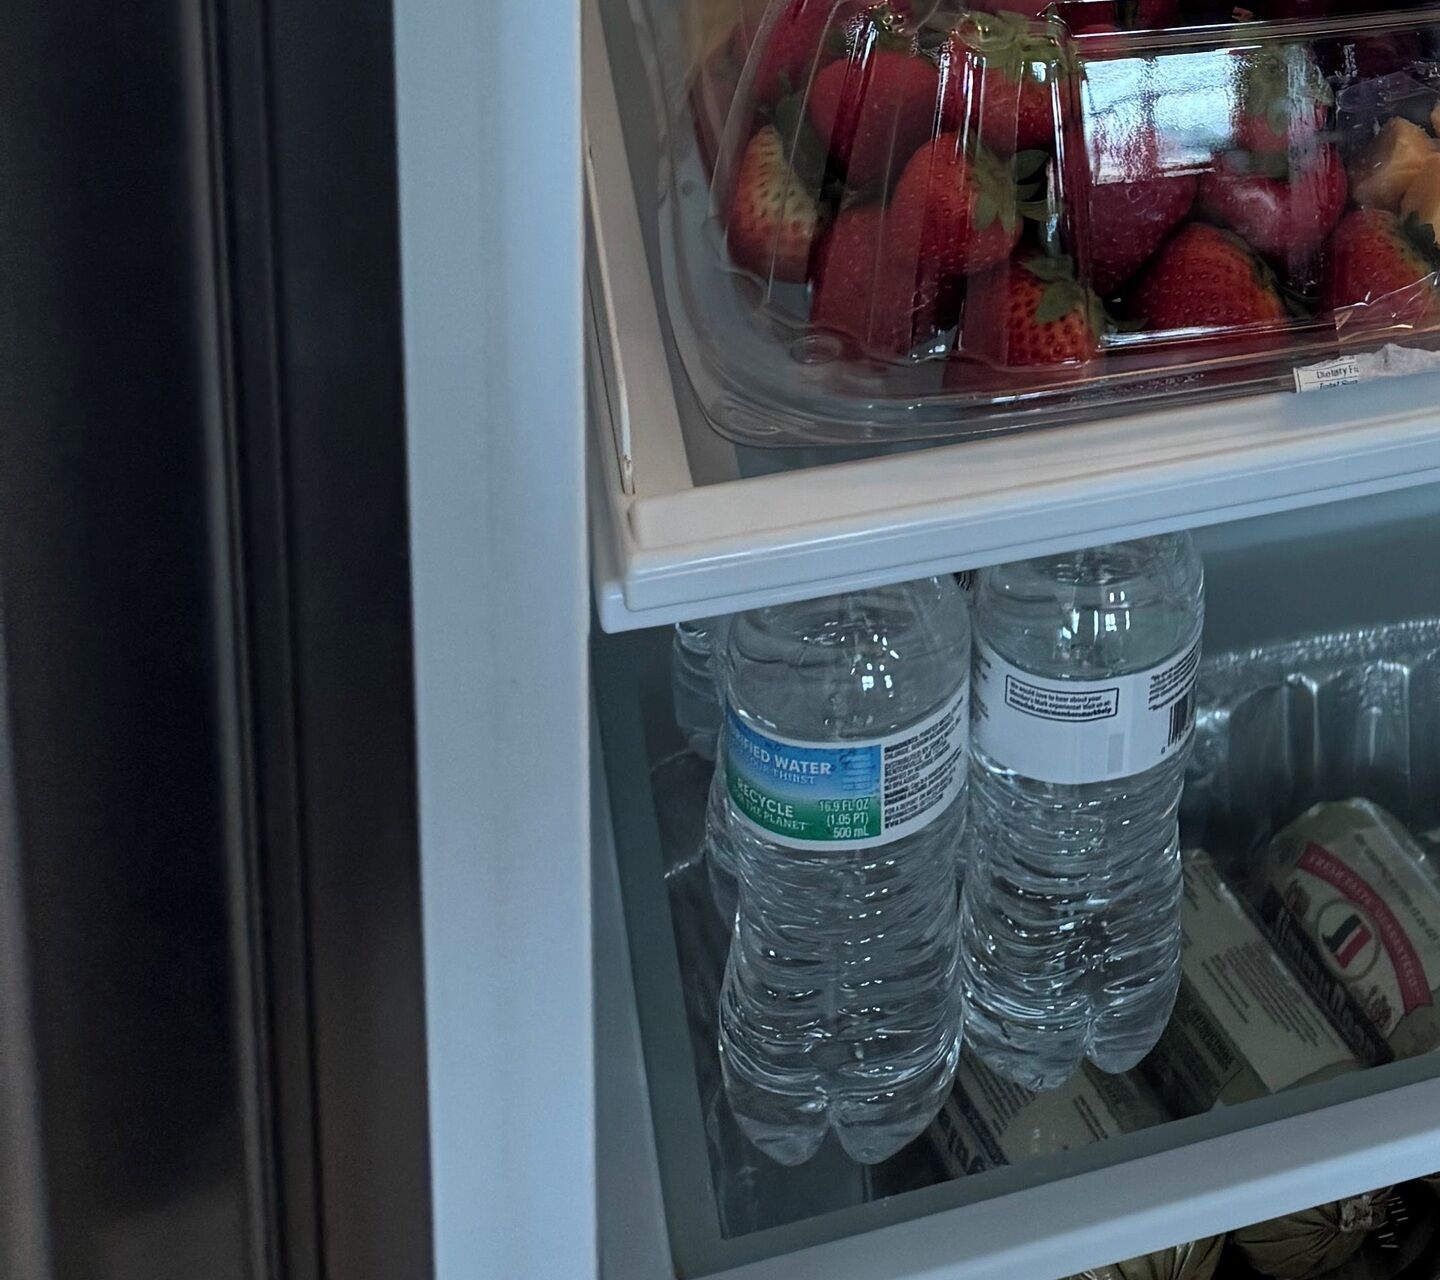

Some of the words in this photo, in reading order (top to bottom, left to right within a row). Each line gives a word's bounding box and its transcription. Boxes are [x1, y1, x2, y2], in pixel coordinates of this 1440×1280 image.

[773, 754, 832, 776] WATER
[736, 776, 794, 819] RECYCLE
[818, 800, 841, 812] 16.9
[842, 799, 855, 811] FL
[855, 798, 869, 811] OZ
[763, 810, 806, 831] PLANET
[826, 812, 852, 827] (1.05
[852, 811, 869, 826] PT)
[832, 827, 851, 839] 500
[854, 826, 869, 838] mL
